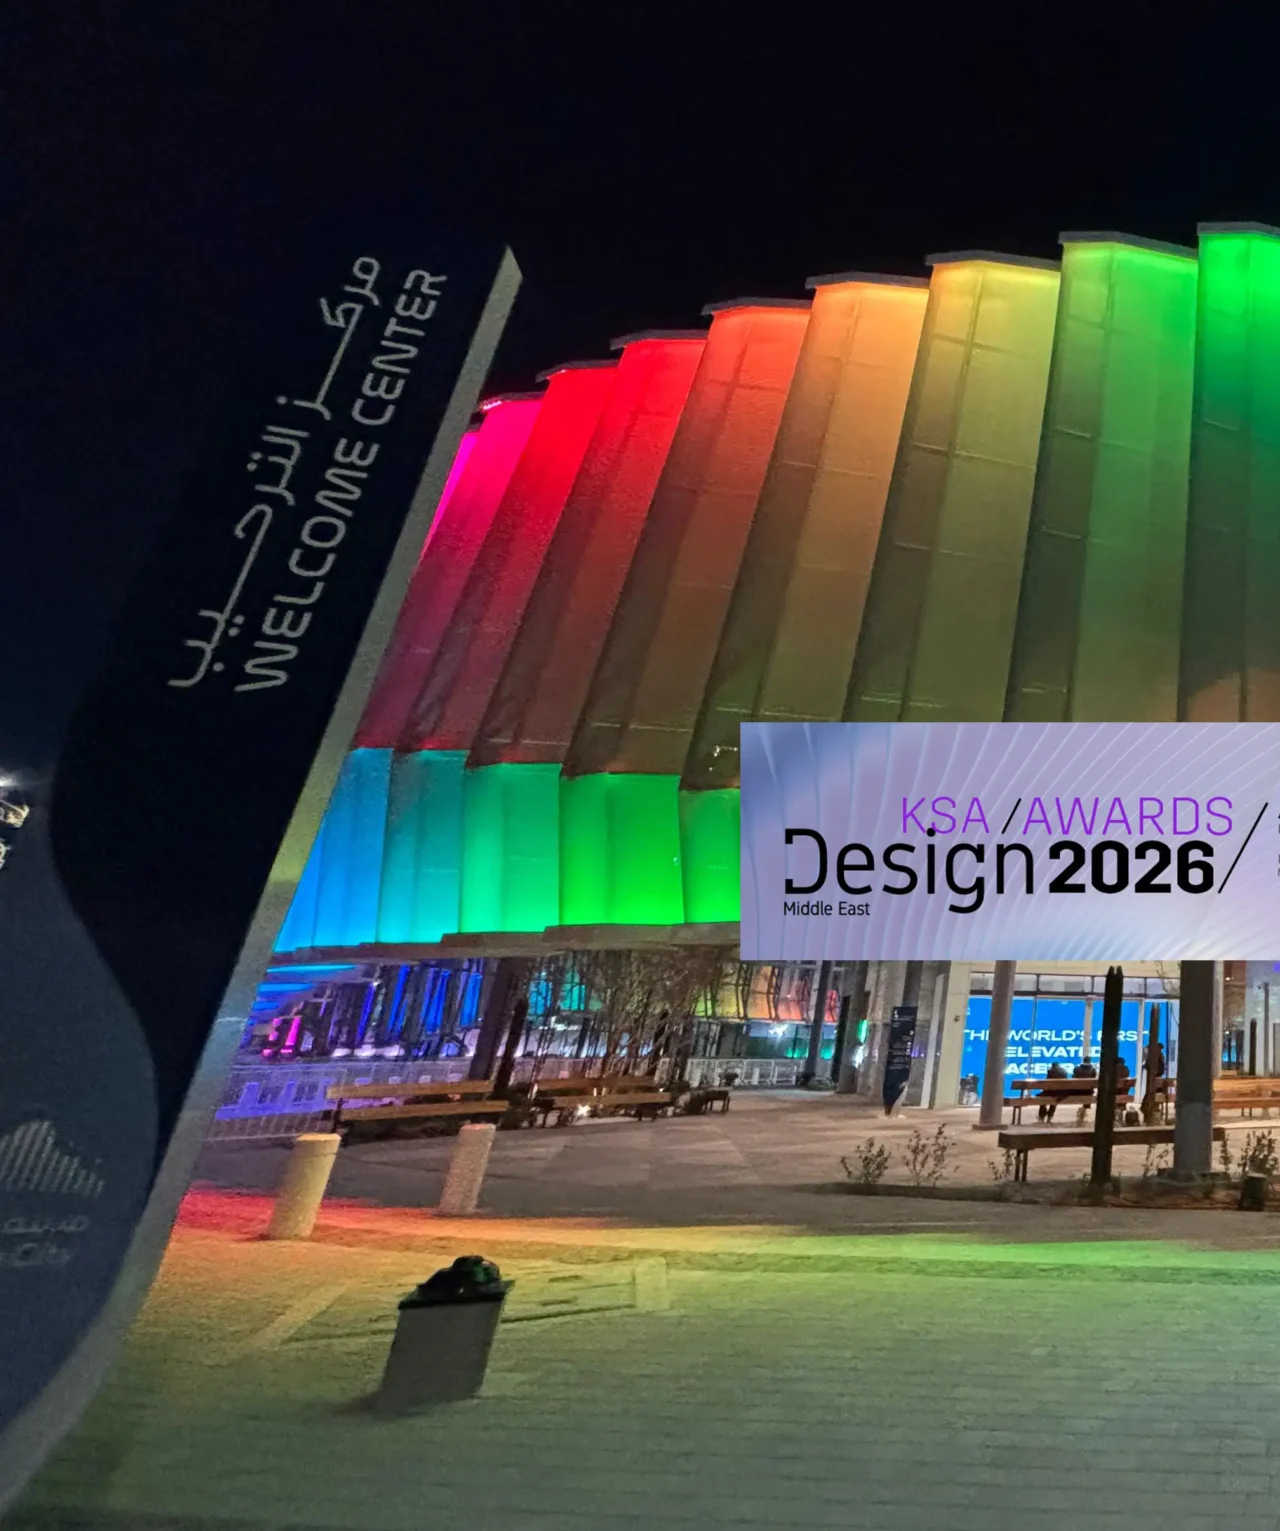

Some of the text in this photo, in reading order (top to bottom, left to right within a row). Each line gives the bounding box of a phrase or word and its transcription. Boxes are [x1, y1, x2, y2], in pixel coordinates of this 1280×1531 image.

[169, 257, 380, 687] مركز الترحيب
[235, 269, 447, 691] WELCOME CENTER
